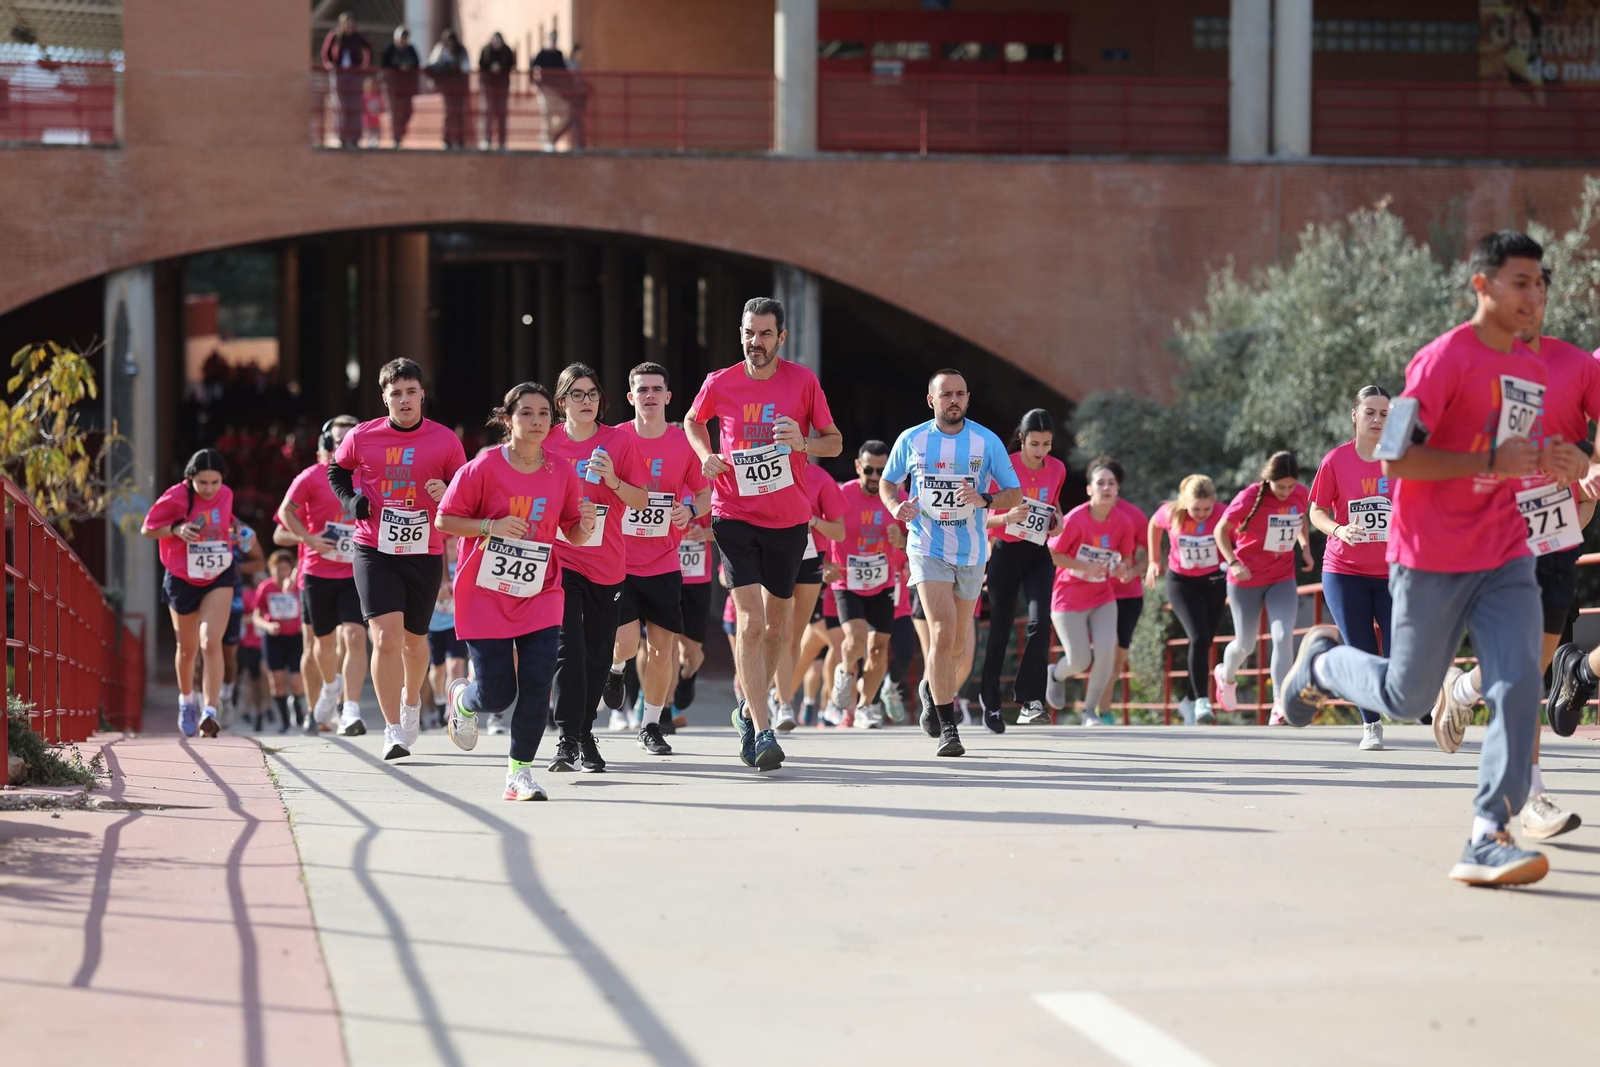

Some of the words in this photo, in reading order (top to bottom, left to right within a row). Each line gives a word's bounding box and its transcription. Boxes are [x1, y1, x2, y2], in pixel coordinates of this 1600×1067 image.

[1527, 57, 1559, 81] de
[743, 403, 775, 423] WE
[1508, 404, 1533, 433] 60
[745, 426, 772, 439] RUN
[385, 447, 415, 466] WE
[734, 455, 760, 465] UMA
[387, 467, 411, 479] RUN
[745, 459, 783, 482] 405
[381, 480, 417, 499] UMA
[925, 481, 949, 489] UMA
[1360, 476, 1389, 494] WE
[1026, 487, 1049, 502] WE
[509, 495, 547, 522] WE
[1350, 504, 1375, 512] UMA
[1517, 501, 1538, 513] MA
[384, 514, 406, 525] UMA
[628, 508, 665, 525] 388
[861, 510, 883, 525] WE
[1364, 512, 1388, 529] 95
[387, 525, 423, 542] 586
[1279, 528, 1294, 541] 11
[489, 541, 518, 557] UMA
[857, 537, 885, 553] UMA
[195, 554, 225, 568] 451
[680, 553, 700, 566] 00
[1186, 548, 1211, 560] 111
[491, 555, 538, 583] 348
[854, 567, 883, 581] 392
